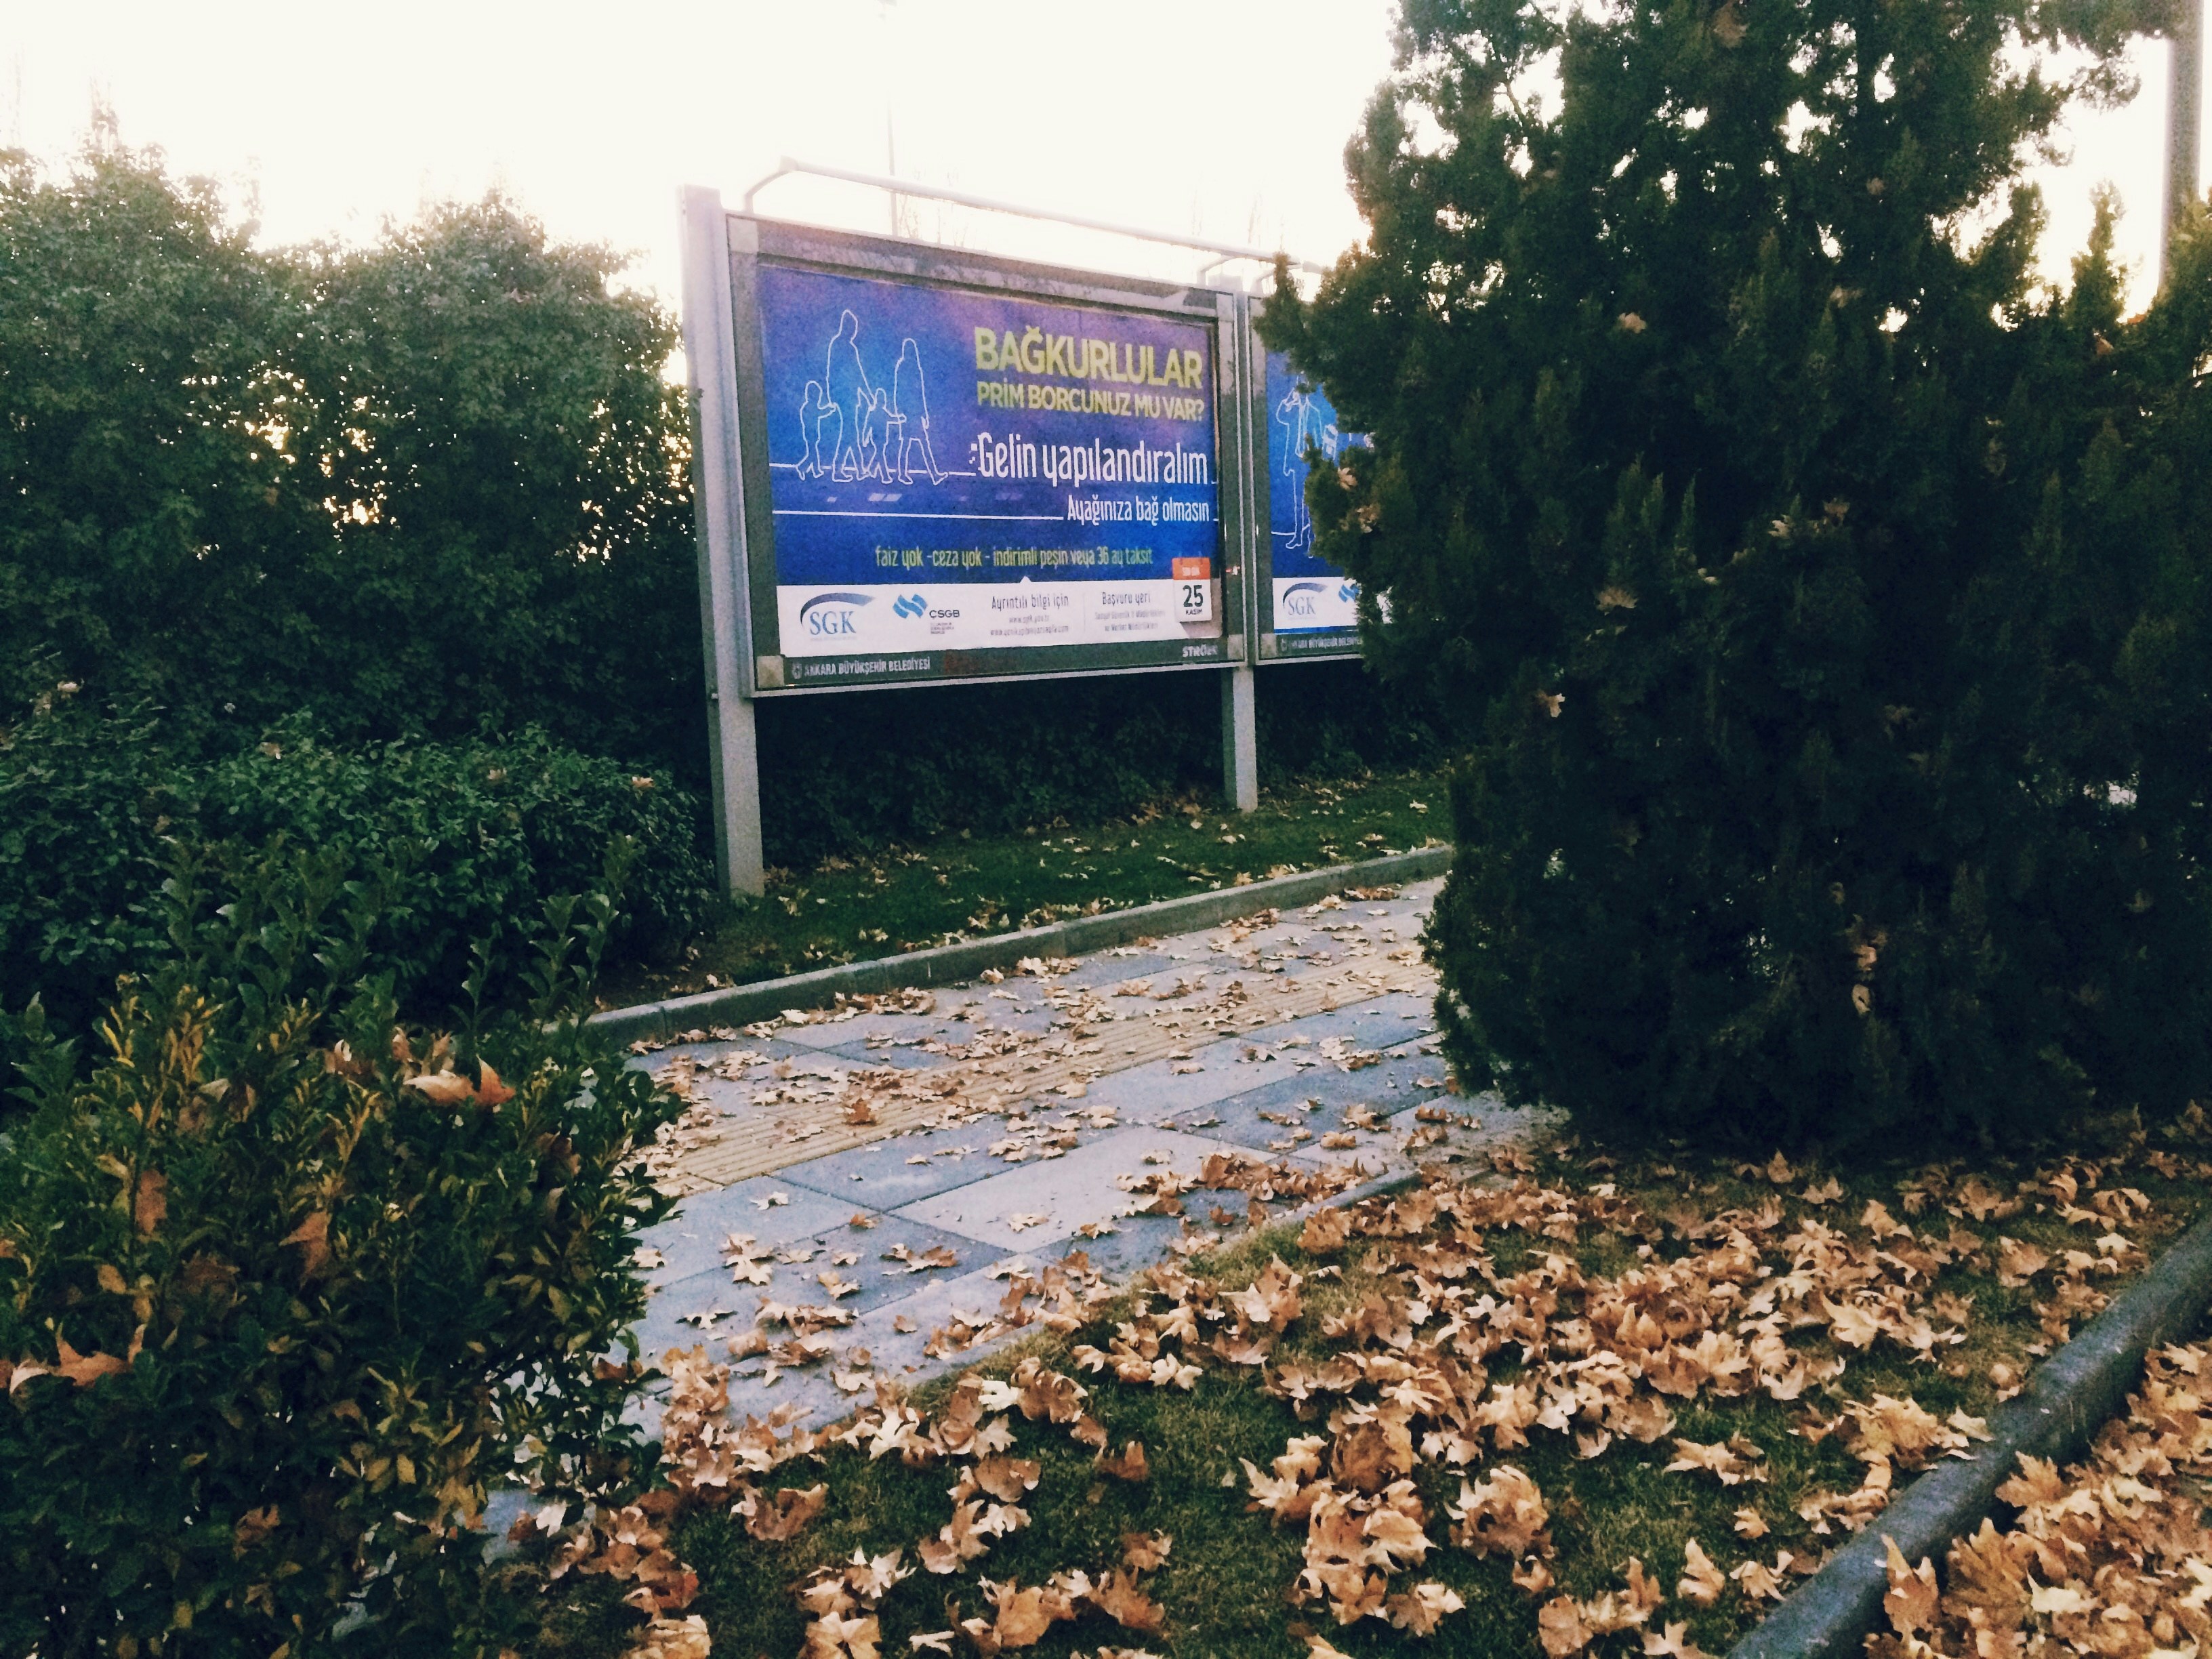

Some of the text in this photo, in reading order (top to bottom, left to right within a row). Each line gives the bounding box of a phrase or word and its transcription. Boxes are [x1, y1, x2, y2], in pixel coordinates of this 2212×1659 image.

[975, 325, 1203, 389] BAĞKURLULAR
[977, 377, 1205, 422] PRİM BORCUNUZ MU VAR?
[977, 432, 1208, 487] Gelin yapılandıralım
[1067, 494, 1210, 527] Ayağınıza bağ olmasın
[875, 545, 899, 567] faiz
[901, 545, 924, 571] yok
[962, 546, 982, 571] yok
[993, 546, 1038, 567] indirimli
[1040, 546, 1069, 570] peşin
[1070, 549, 1095, 569] veya
[1097, 546, 1109, 565] 36
[1111, 548, 1124, 569] ay
[1125, 546, 1153, 565] taksit
[991, 593, 1069, 612] Ayrıntılı bilgi için
[1102, 591, 1151, 607] Başvuru yeri
[1183, 585, 1204, 608] 25
[1288, 596, 1316, 616] SGK
[809, 611, 857, 635] SGK
[804, 656, 930, 676] ANKARA BÜYÜKŞEHİR BELEDİYESİ
